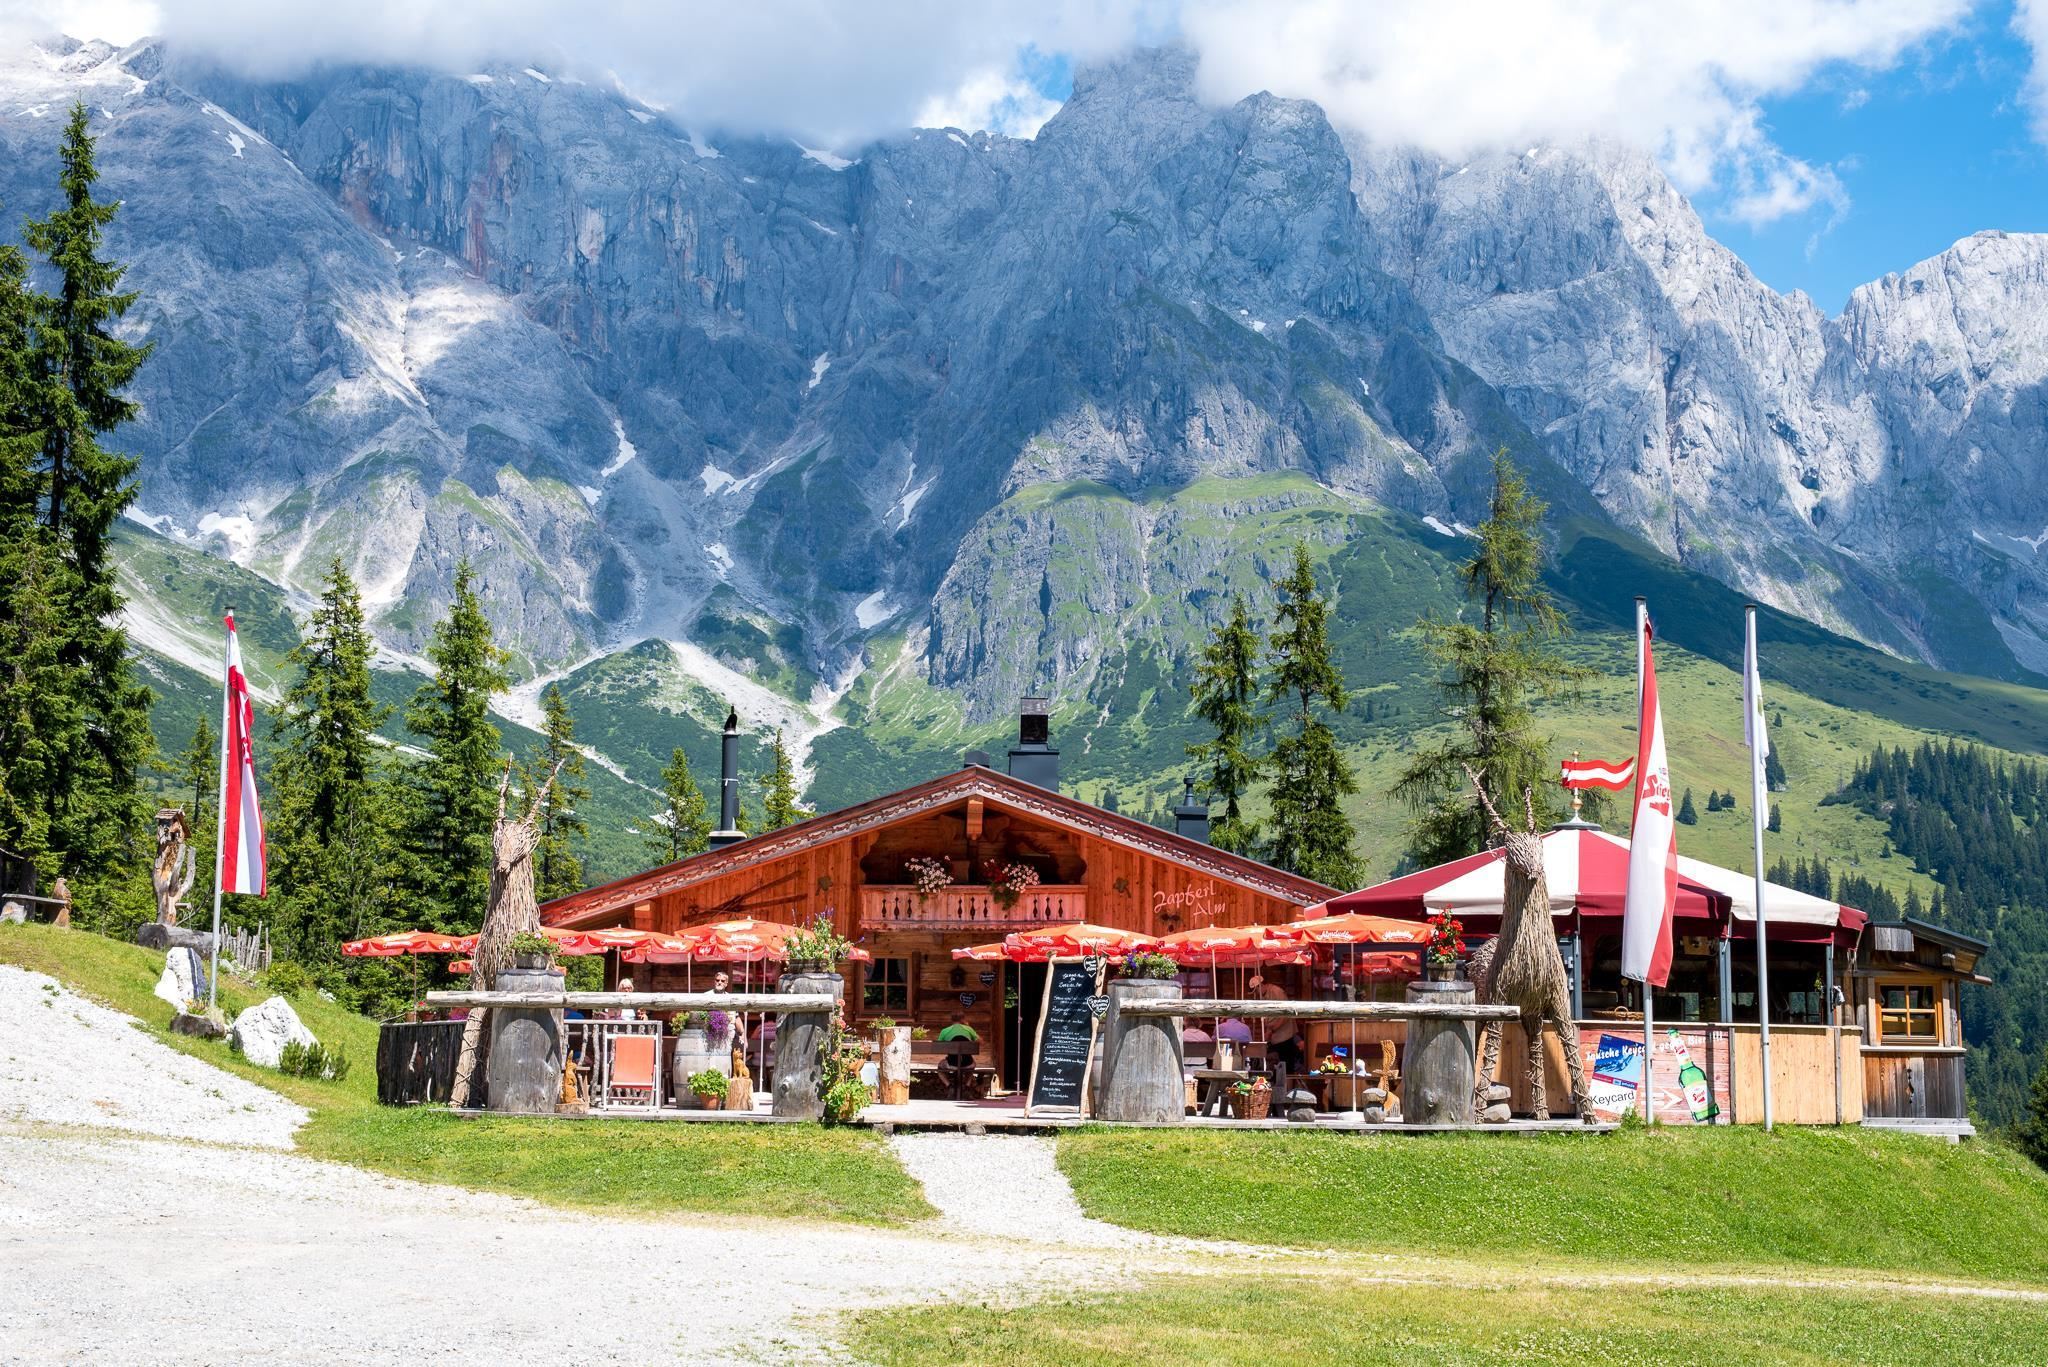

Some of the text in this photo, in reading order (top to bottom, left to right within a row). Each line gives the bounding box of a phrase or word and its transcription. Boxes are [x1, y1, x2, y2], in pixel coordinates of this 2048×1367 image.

[1153, 880, 1216, 914] Zapferl
[1193, 902, 1226, 923] Alm
[1590, 1091, 1635, 1107] Keycard
